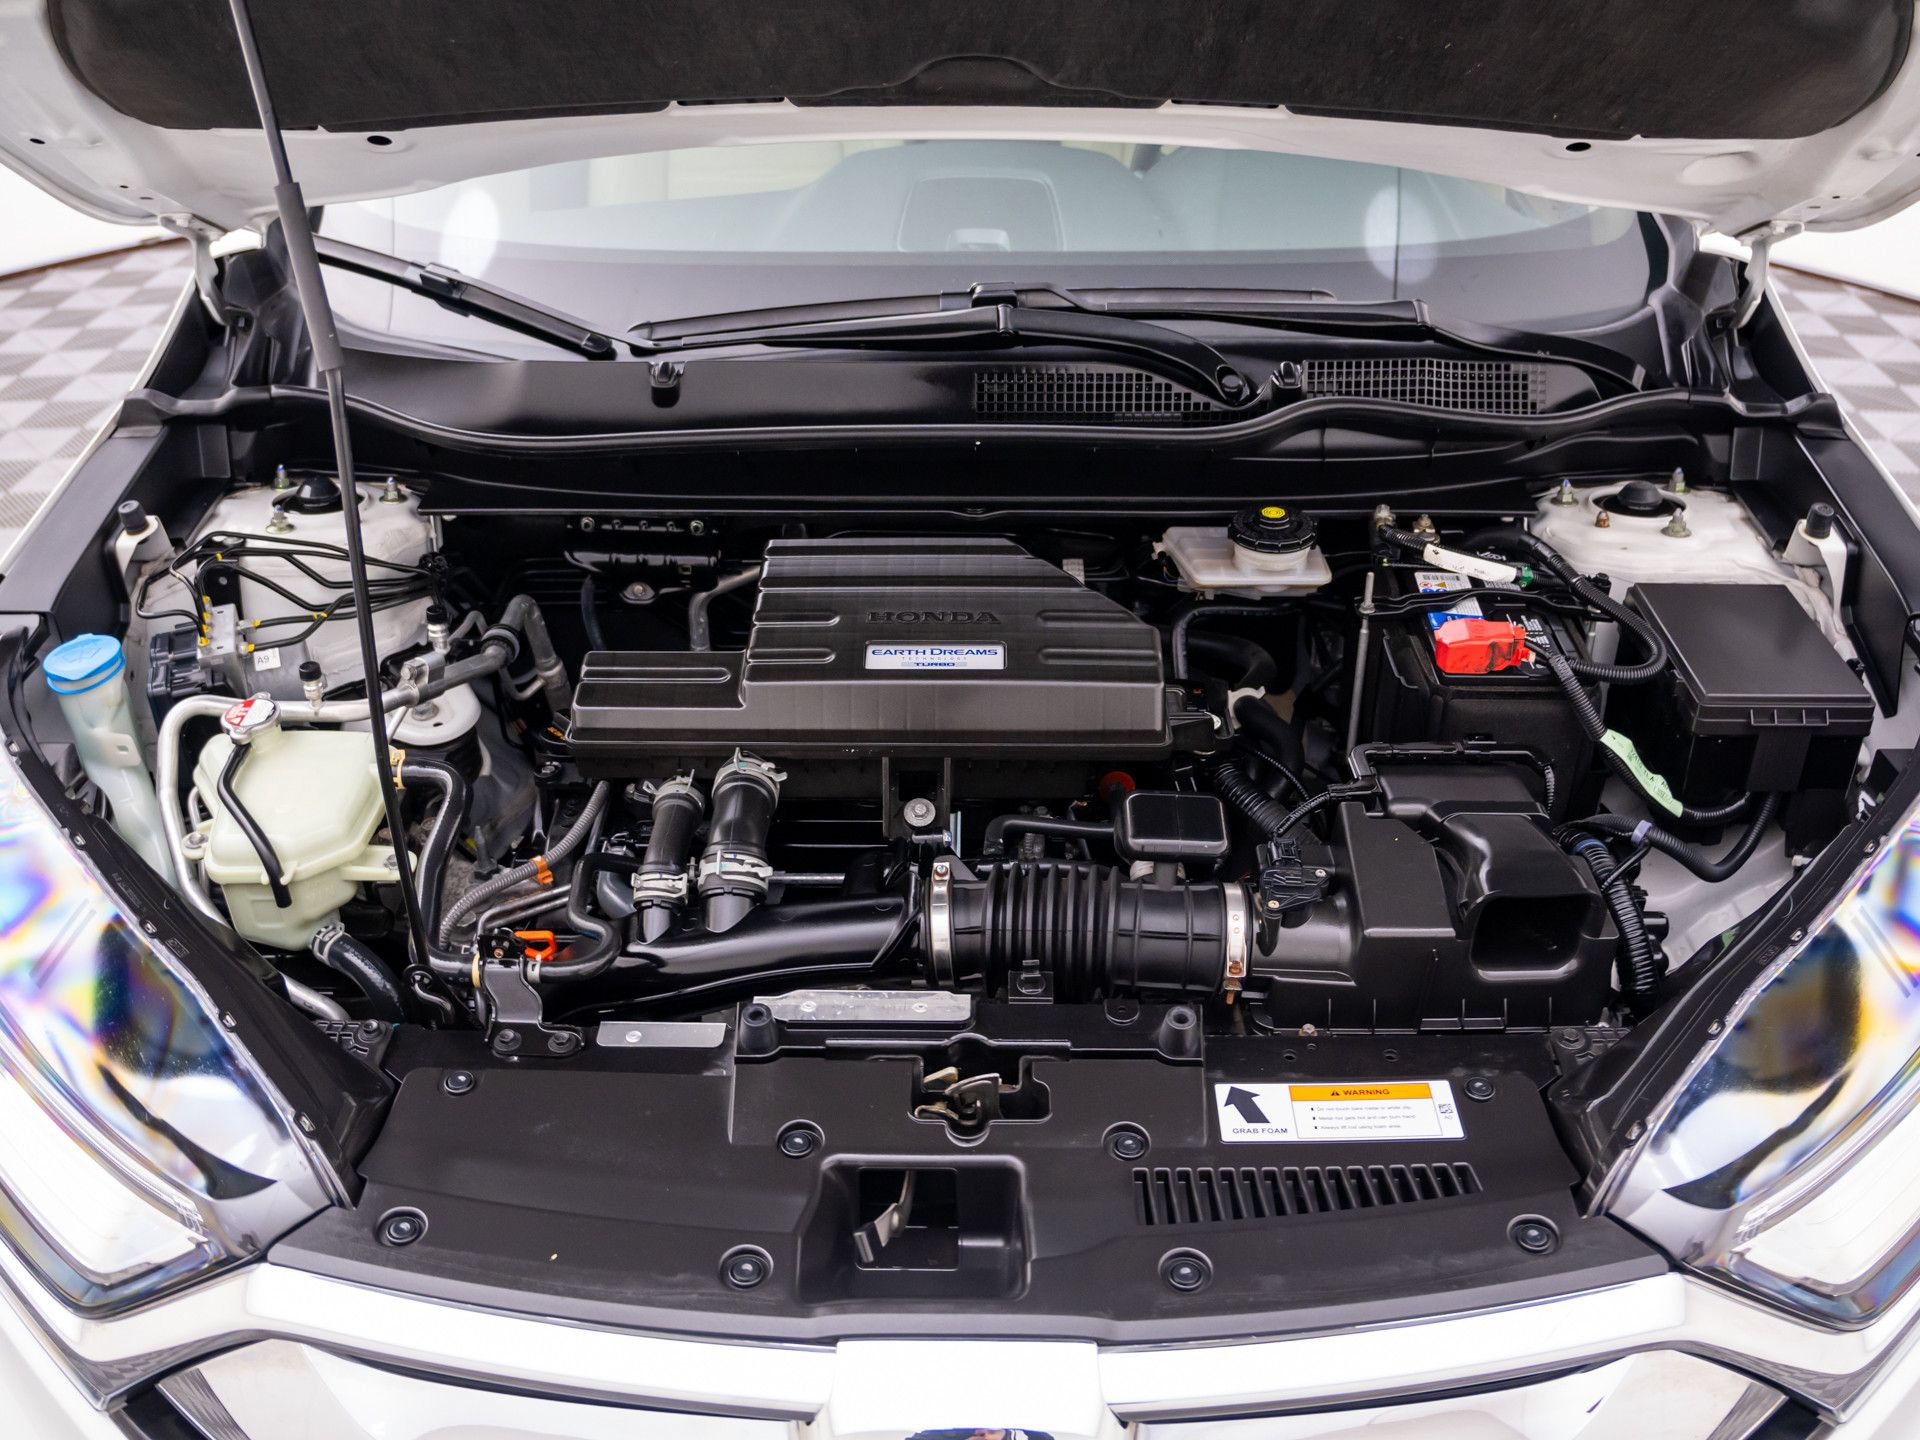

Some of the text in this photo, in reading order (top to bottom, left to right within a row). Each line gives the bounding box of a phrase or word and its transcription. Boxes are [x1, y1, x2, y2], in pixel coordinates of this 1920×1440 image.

[867, 611, 1002, 624] HONDA
[871, 647, 998, 656] EARTH DREAMS
[257, 655, 270, 665] A9
[1343, 1088, 1390, 1096] WARNING
